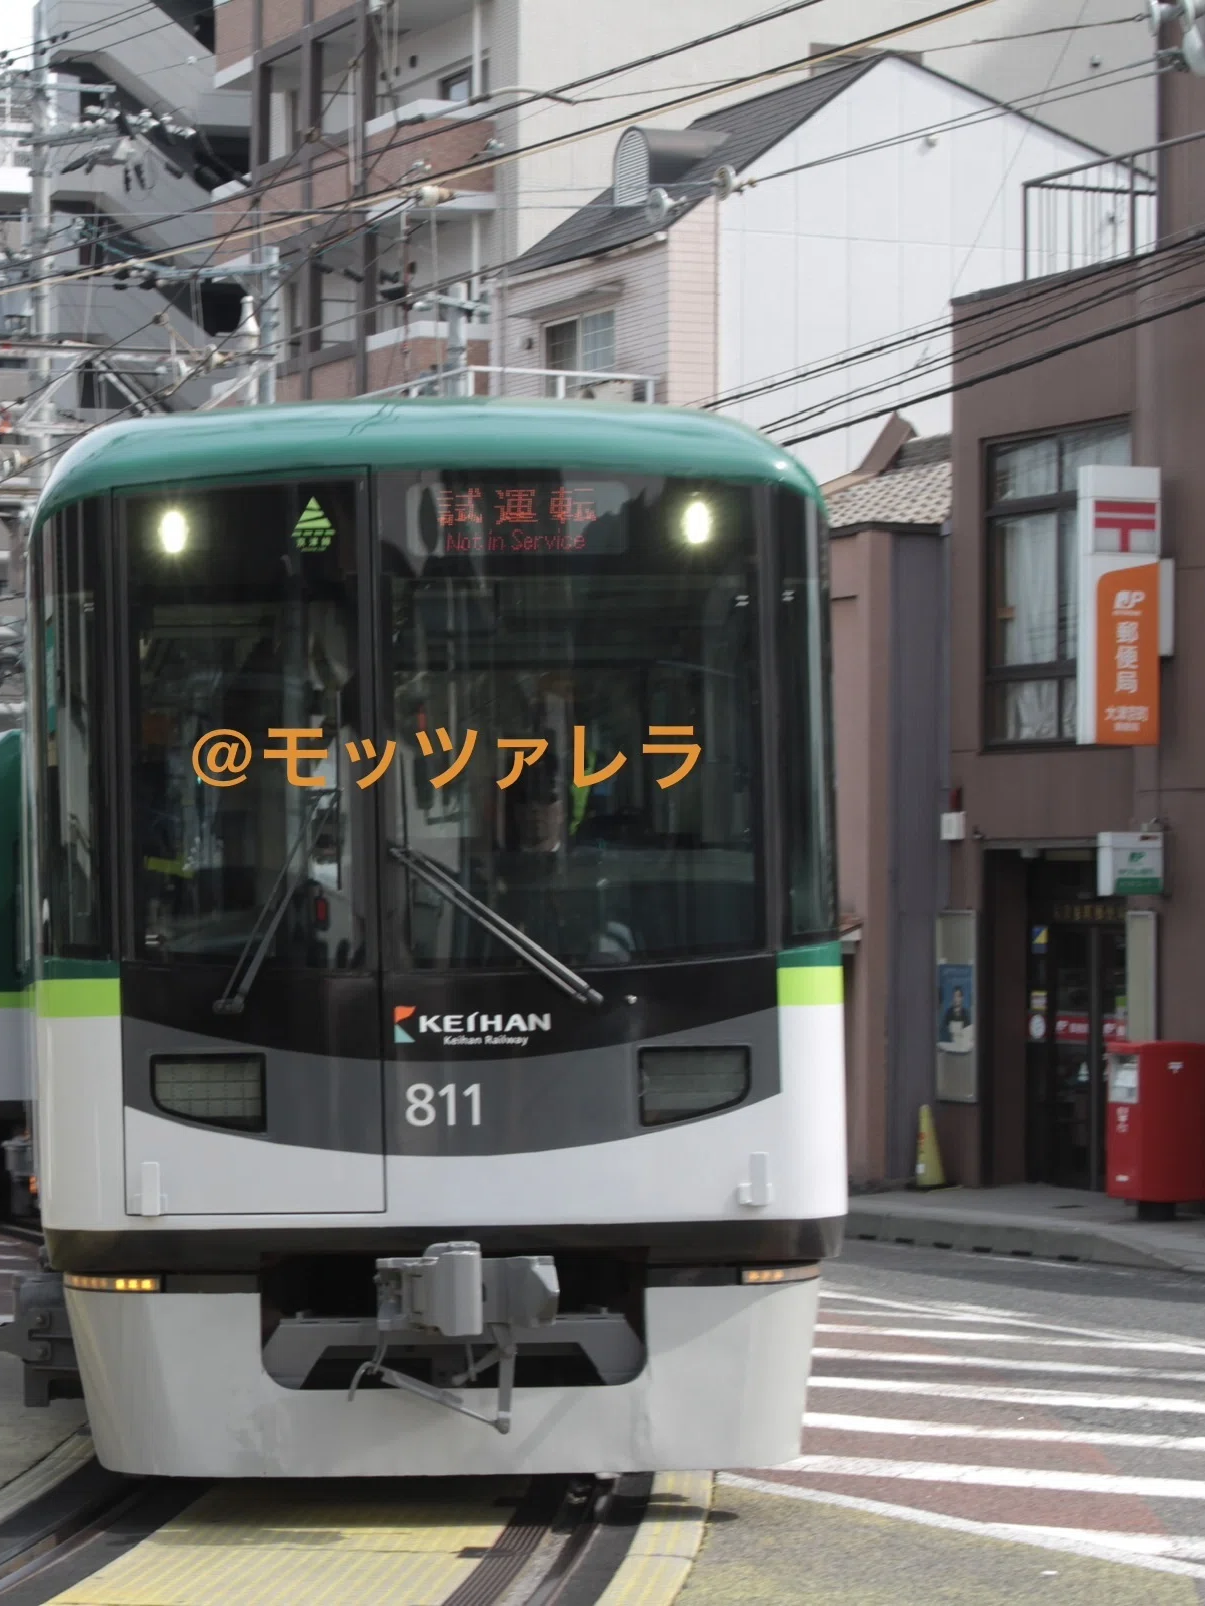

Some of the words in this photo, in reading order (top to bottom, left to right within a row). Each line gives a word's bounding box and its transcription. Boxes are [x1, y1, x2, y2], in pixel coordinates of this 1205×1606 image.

[437, 486, 597, 526] 試運転
[446, 531, 481, 551] Not
[488, 528, 506, 550] in
[511, 528, 586, 551] Service
[1115, 620, 1139, 694] 郵便局
[418, 1011, 552, 1033] KEIHAN
[443, 1034, 483, 1045] Keihan
[484, 1034, 529, 1047] Railway
[405, 1083, 482, 1127] 811
